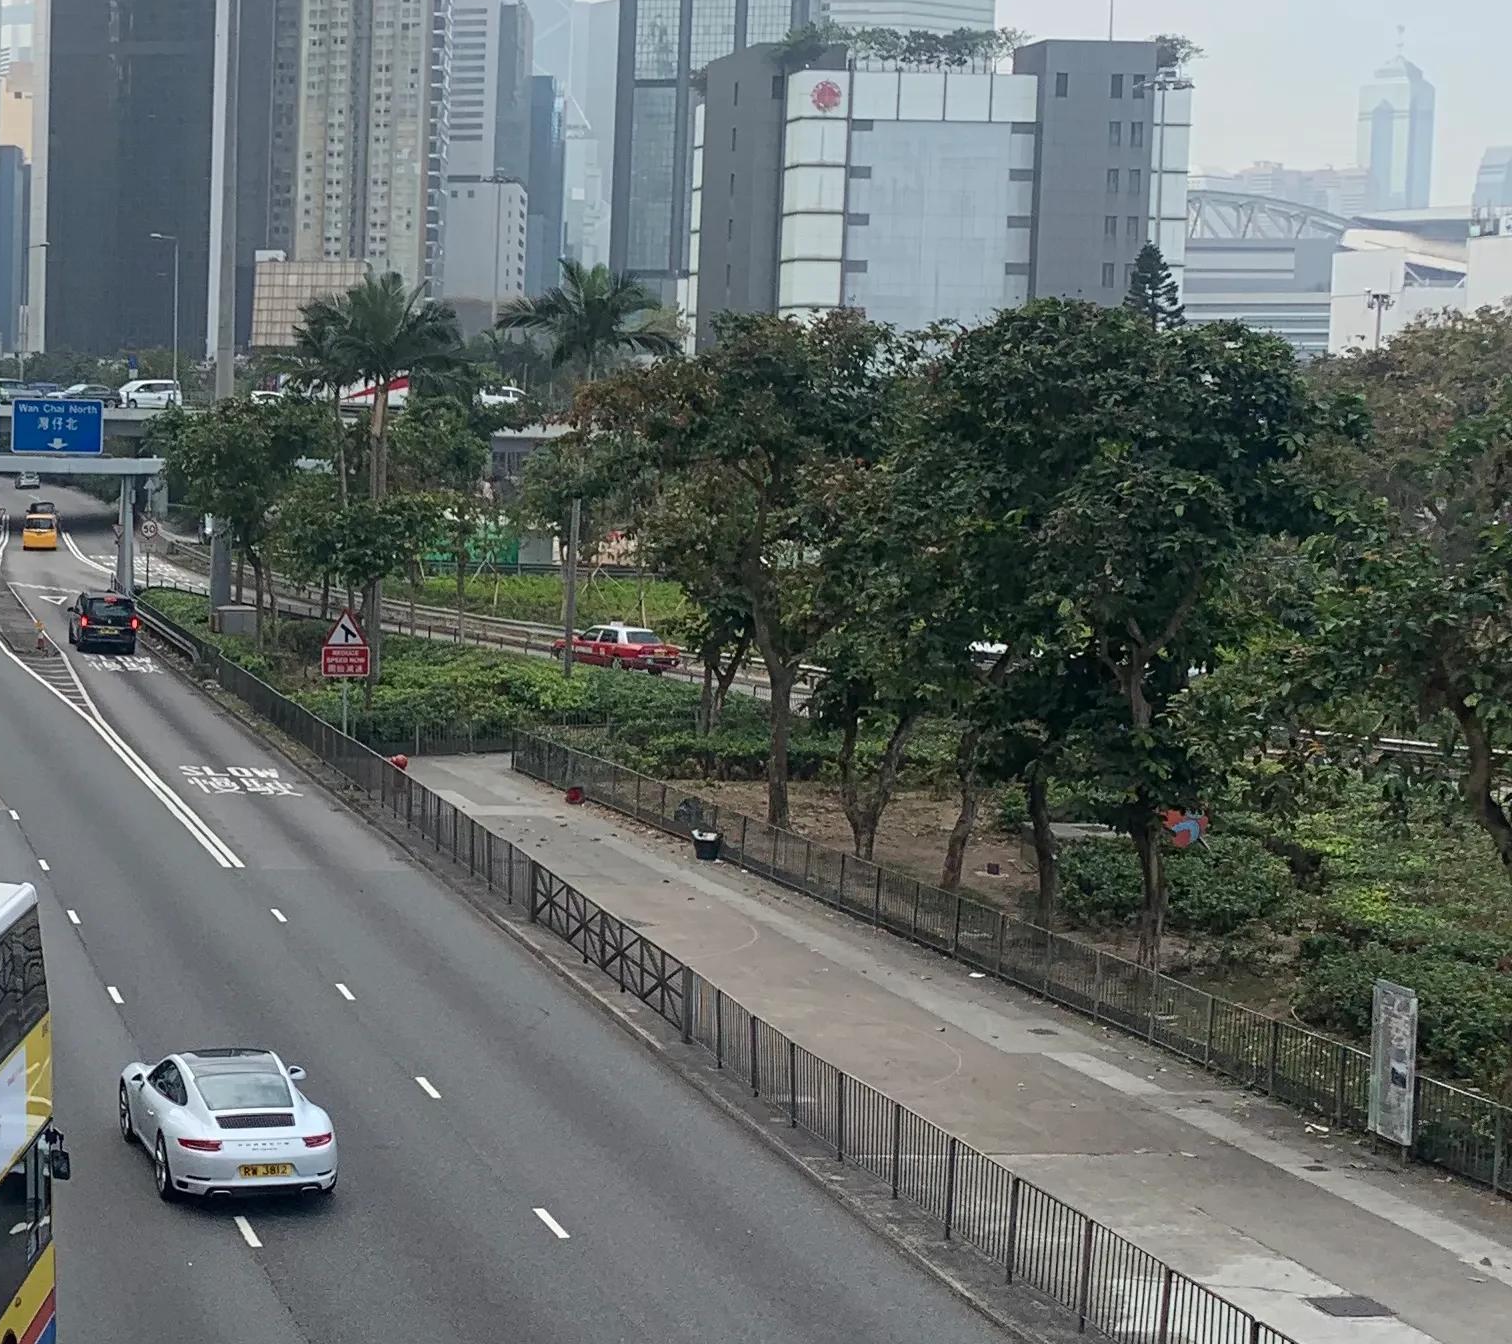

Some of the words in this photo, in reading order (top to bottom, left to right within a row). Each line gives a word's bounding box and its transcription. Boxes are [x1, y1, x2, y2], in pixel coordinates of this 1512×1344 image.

[18, 404, 41, 414] Wan
[44, 404, 66, 414] Chai
[69, 404, 98, 415] North
[37, 416, 79, 431] 灣仔北
[143, 525, 156, 533] 50
[178, 765, 280, 779] SLOW
